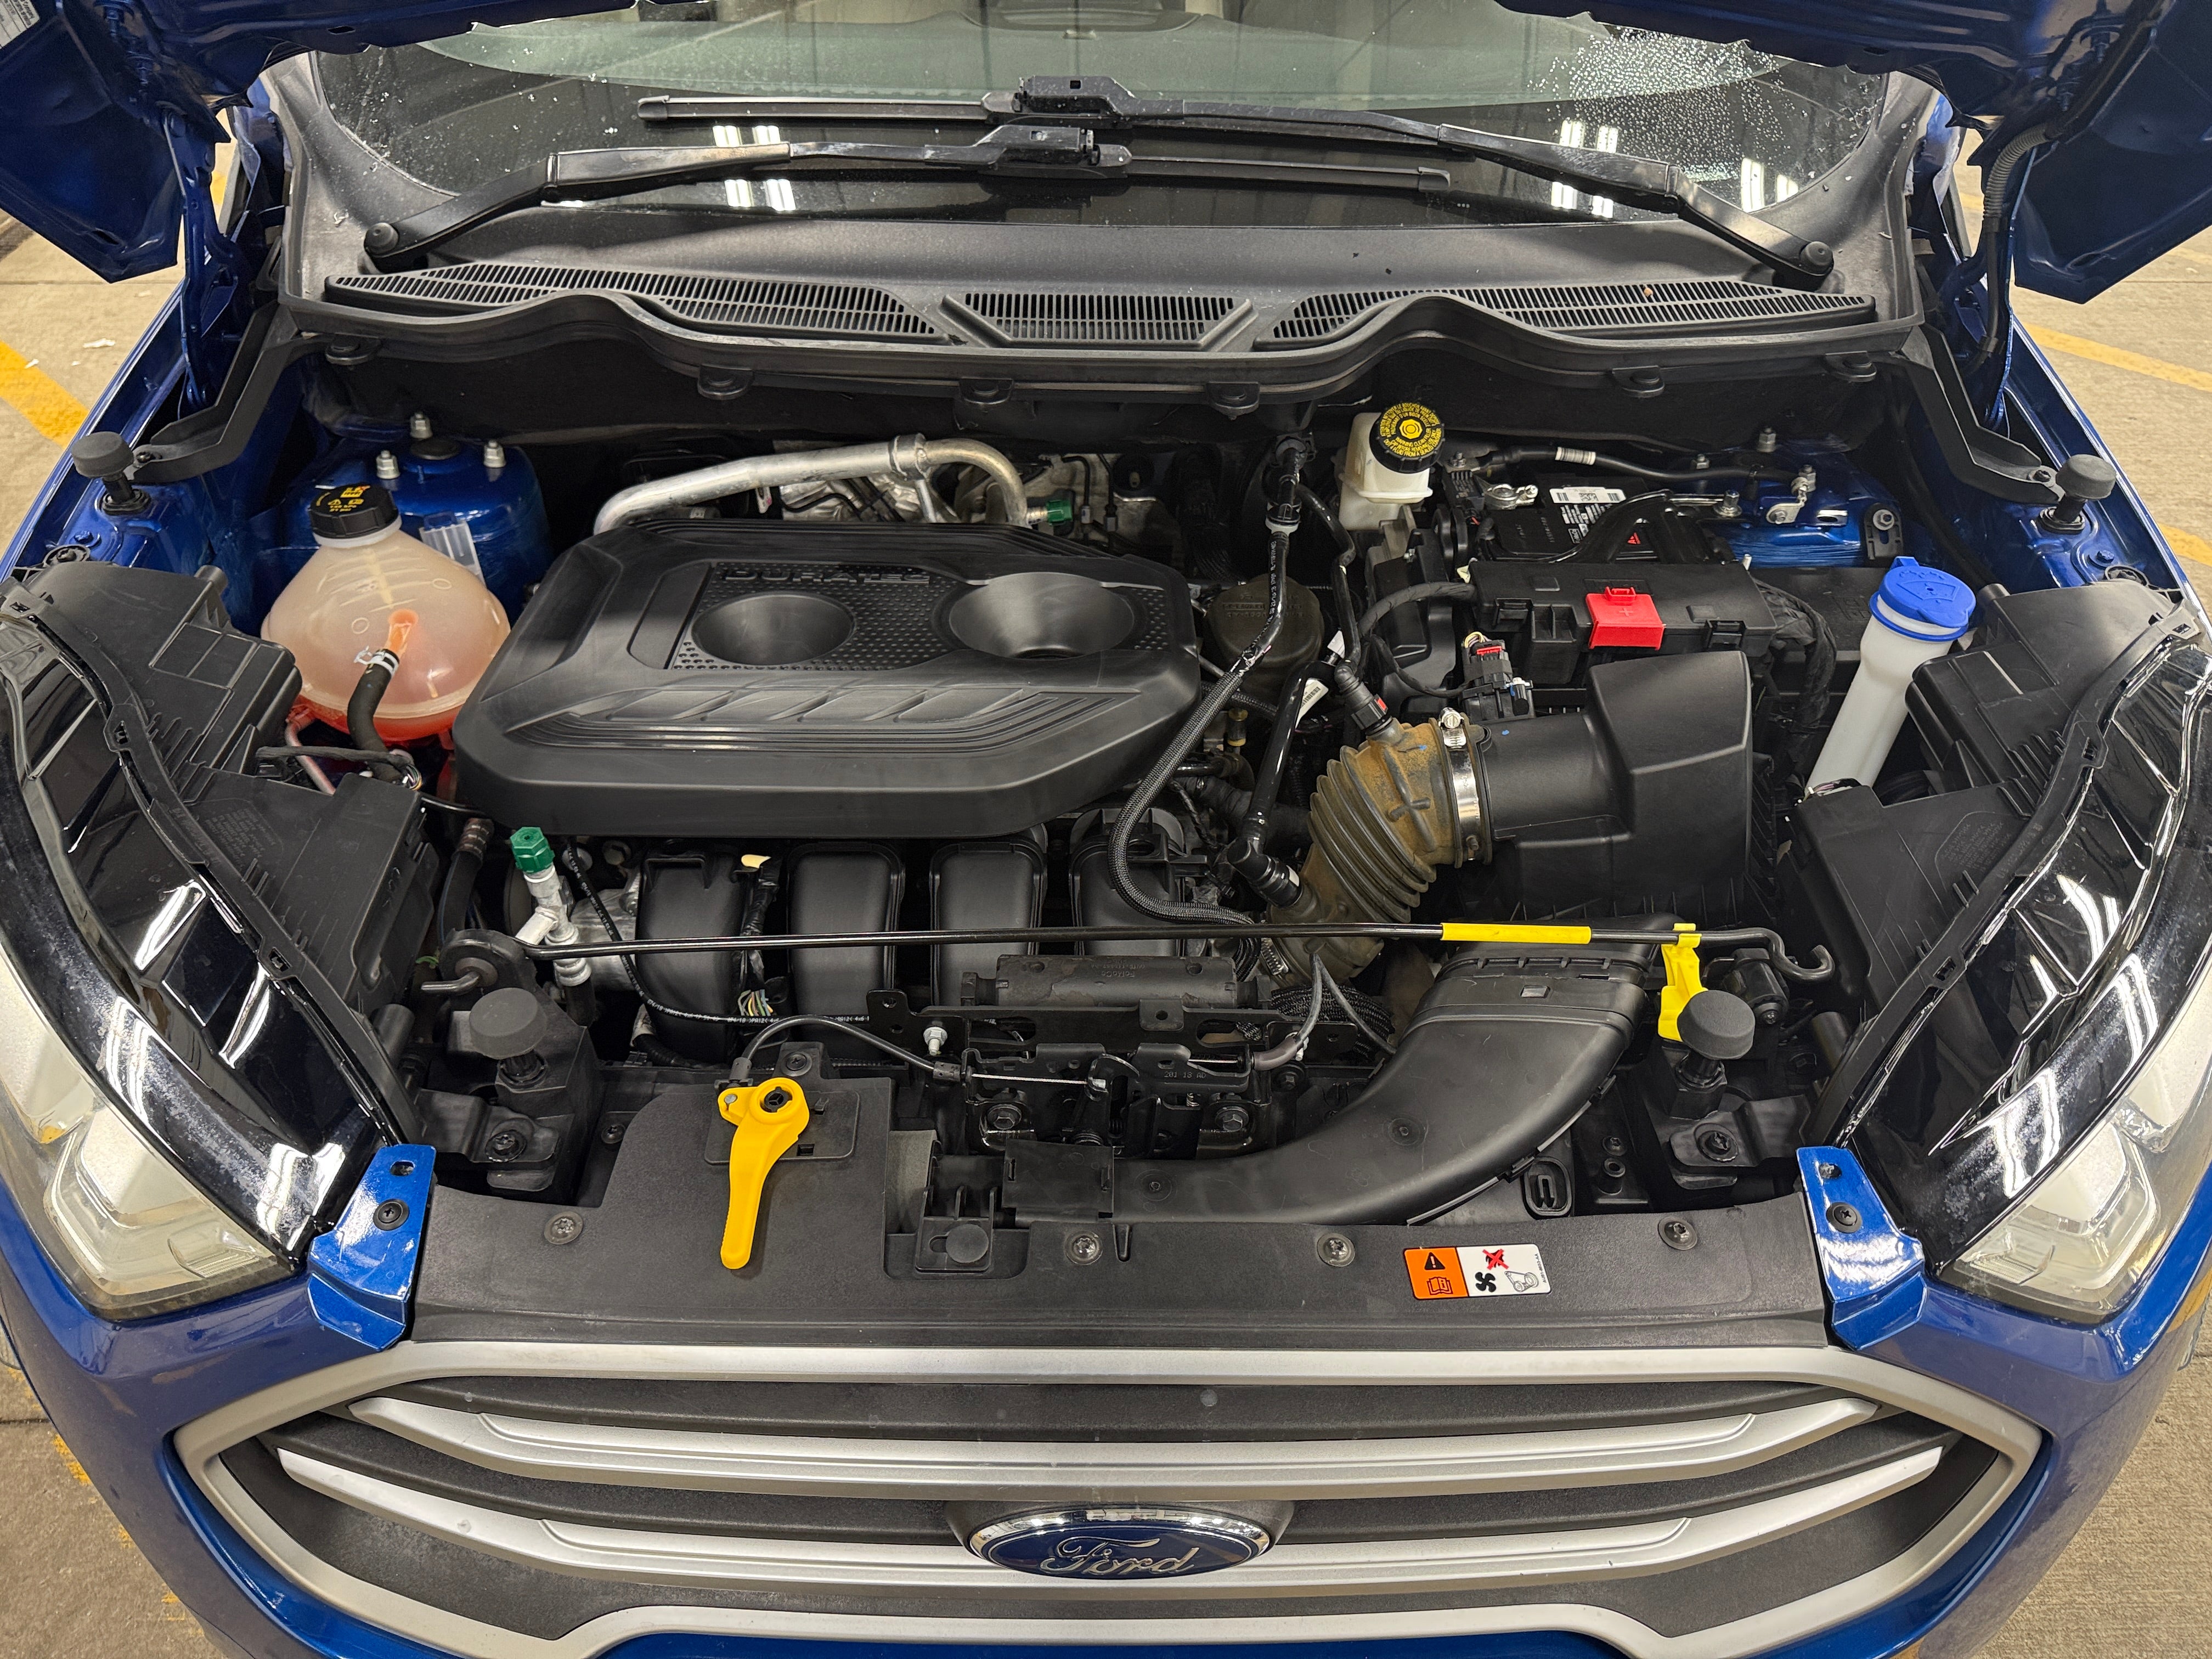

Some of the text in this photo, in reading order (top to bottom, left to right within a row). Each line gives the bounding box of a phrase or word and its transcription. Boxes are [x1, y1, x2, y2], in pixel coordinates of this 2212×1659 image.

[1390, 439, 1400, 448] CAP
[1396, 437, 1414, 447] WARNING
[1414, 437, 1426, 447] CLEAN
[1392, 447, 1404, 456] FLUID
[1419, 444, 1434, 455] SEALED
[725, 568, 930, 584] DURATEC
[1040, 1536, 1200, 1576] Ford
